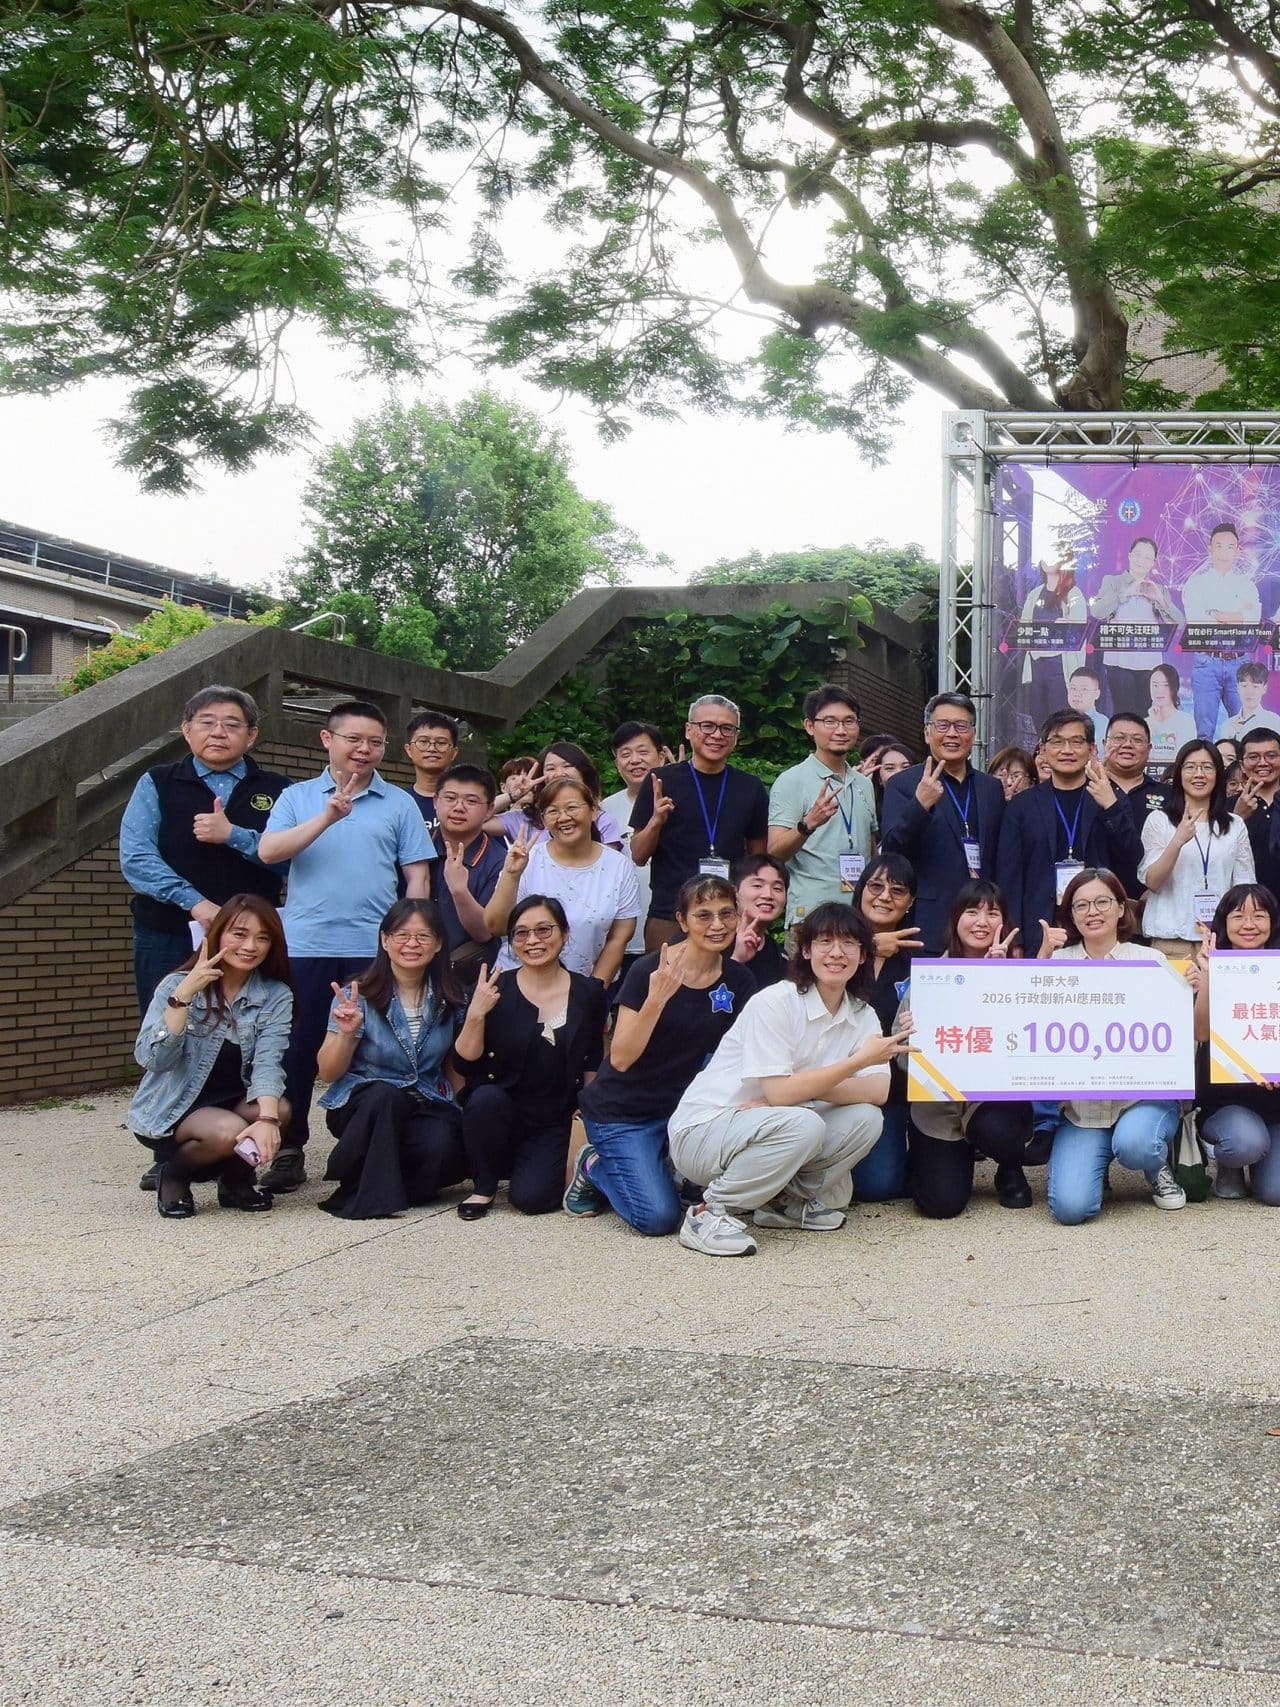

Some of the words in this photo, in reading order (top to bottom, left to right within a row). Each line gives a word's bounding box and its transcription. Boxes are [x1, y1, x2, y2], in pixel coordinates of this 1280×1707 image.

[1213, 628, 1247, 636] SmartFlow
[1255, 628, 1272, 636] Team
[1030, 975, 1079, 987] 中原大學
[982, 993, 1012, 1004] 2026
[1015, 992, 1126, 1005] 行政創新AI應用競賽
[935, 1025, 993, 1054] 特優
